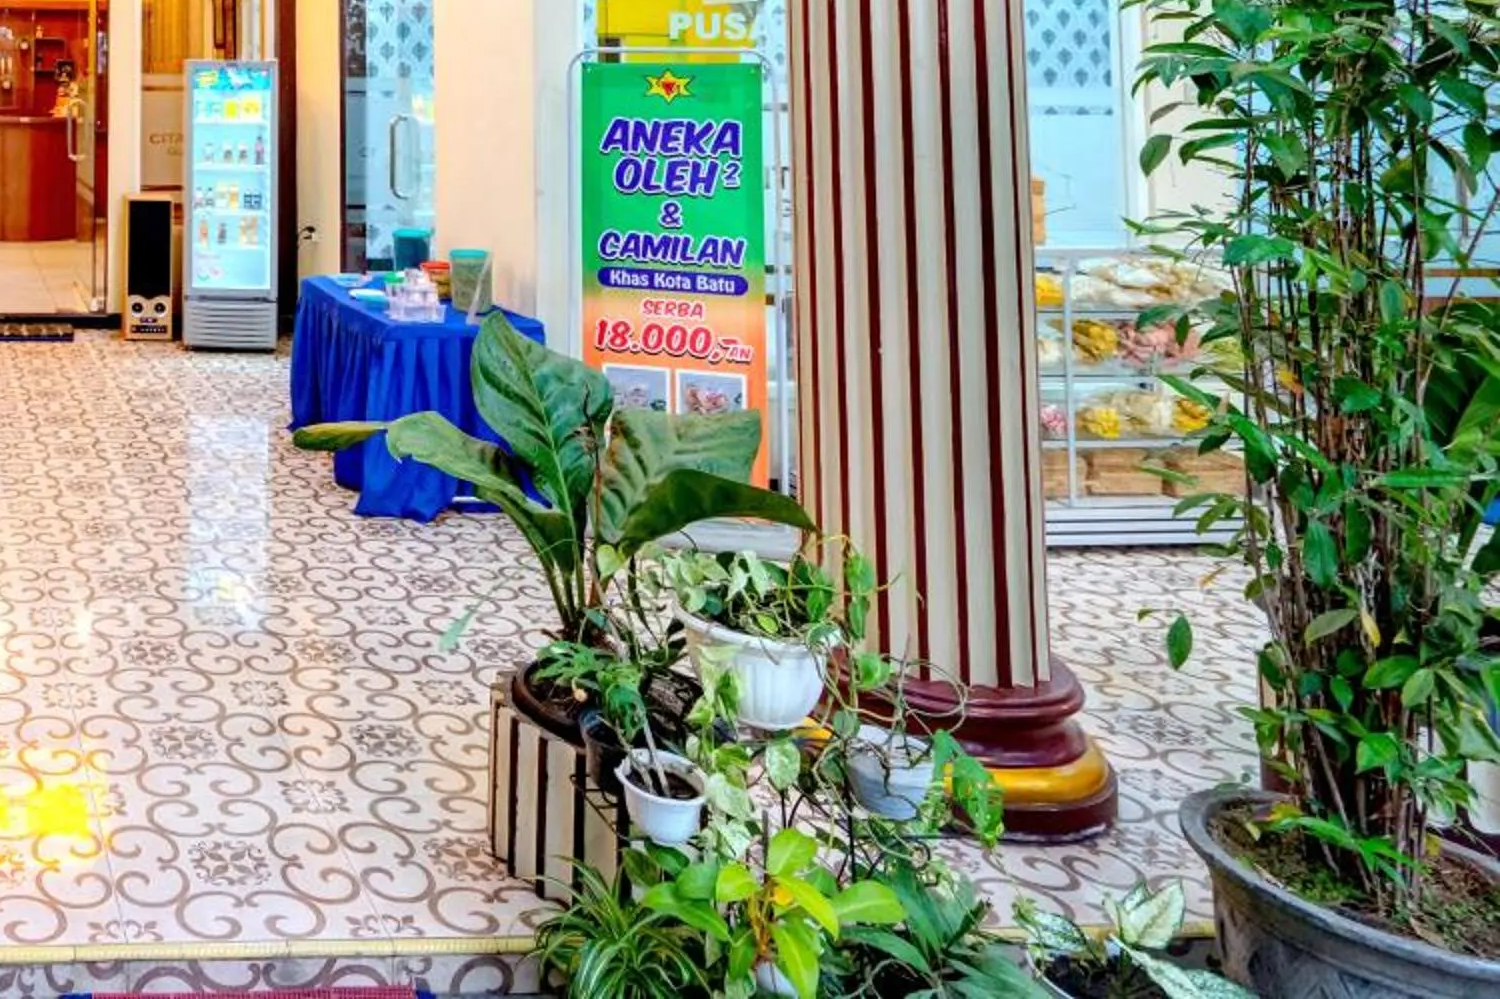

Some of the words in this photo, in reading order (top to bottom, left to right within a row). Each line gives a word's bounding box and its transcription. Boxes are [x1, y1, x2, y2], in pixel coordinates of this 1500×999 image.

[600, 117, 742, 157] ANEKA
[659, 201, 683, 228] &
[598, 230, 747, 267] CAMILAN
[610, 269, 650, 287] Khas
[653, 272, 692, 290] Kota
[696, 275, 736, 293] Batu
[642, 299, 705, 319] SERBA
